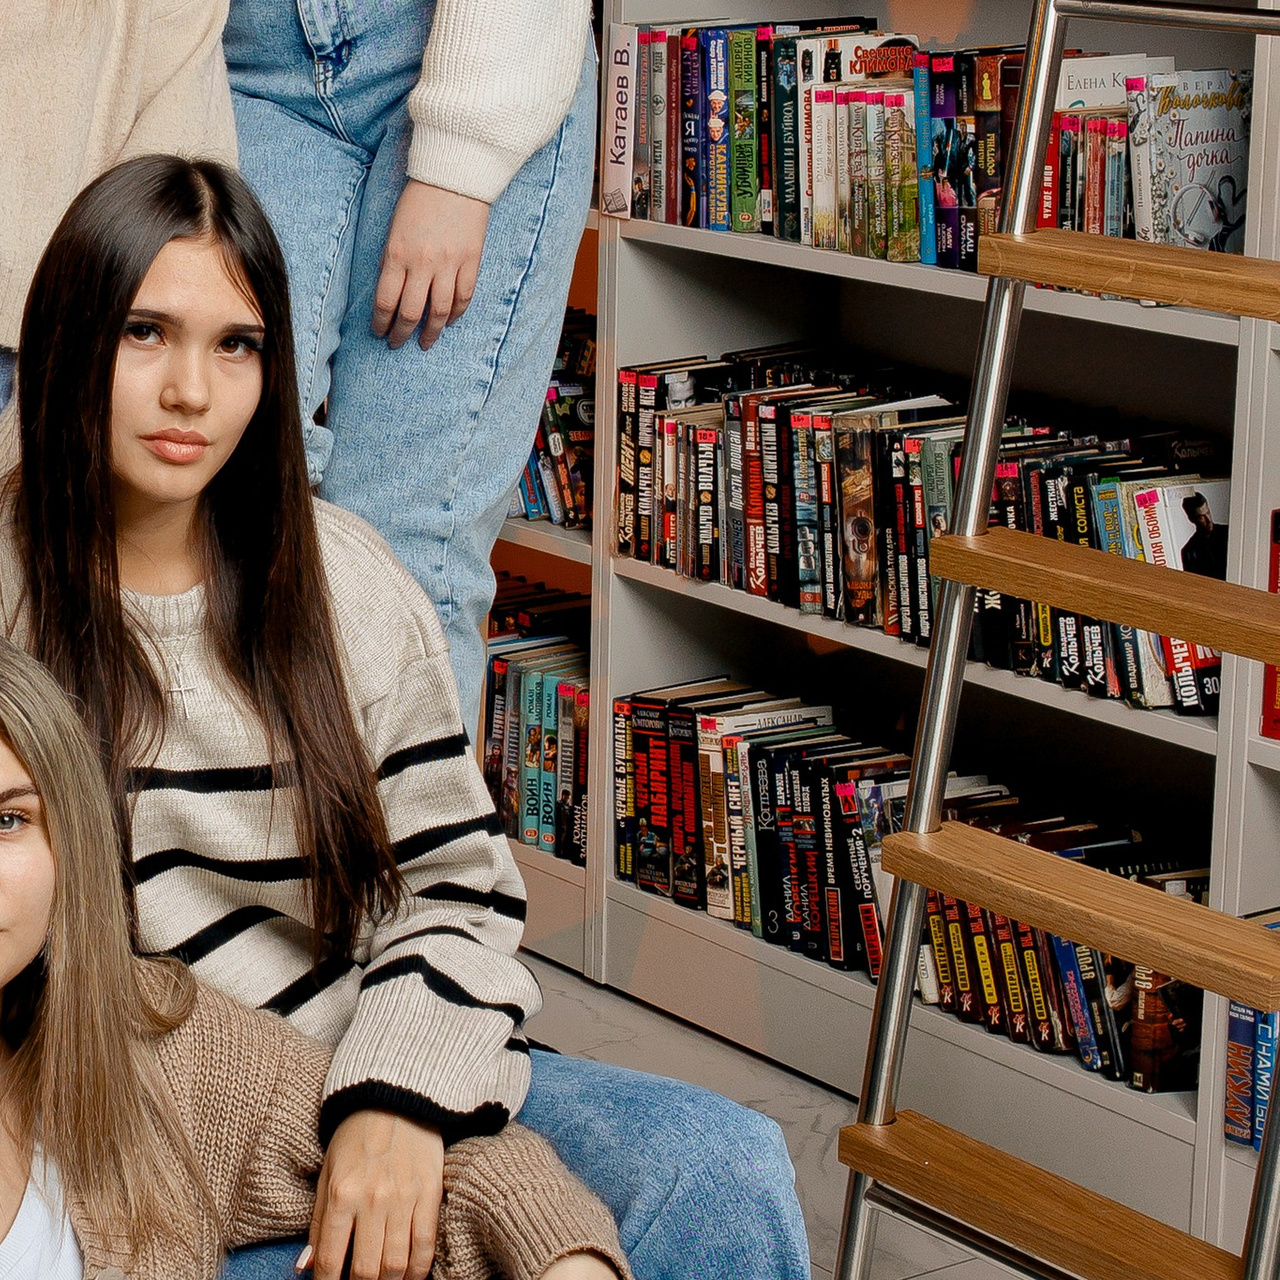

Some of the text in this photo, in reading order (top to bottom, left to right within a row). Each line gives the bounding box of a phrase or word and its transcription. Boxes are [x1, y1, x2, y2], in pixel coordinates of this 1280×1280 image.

[735, 41, 744, 80] АНДРЕЙ
[743, 36, 753, 83] КИВИНОВ
[610, 42, 631, 165] Катаев В.
[782, 100, 795, 203] МАЛЫШ И БУЙВОЛ
[716, 144, 727, 224] КАНИКУЛЫ
[1043, 190, 1053, 218] ЧУЖОЕ
[1073, 486, 1087, 533] СОЛИСТА
[824, 533, 835, 609] АНДРЕЙ КОНСТАНТИНОВ
[1062, 617, 1080, 675] КОЛЫЧЕВ
[1087, 625, 1105, 685] КОЛЫЧЕВ
[649, 737, 668, 827] ЛАБИРИНТ
[825, 853, 836, 884] ВРЕМЯ
[1225, 1041, 1254, 1126] ЛУКИН
